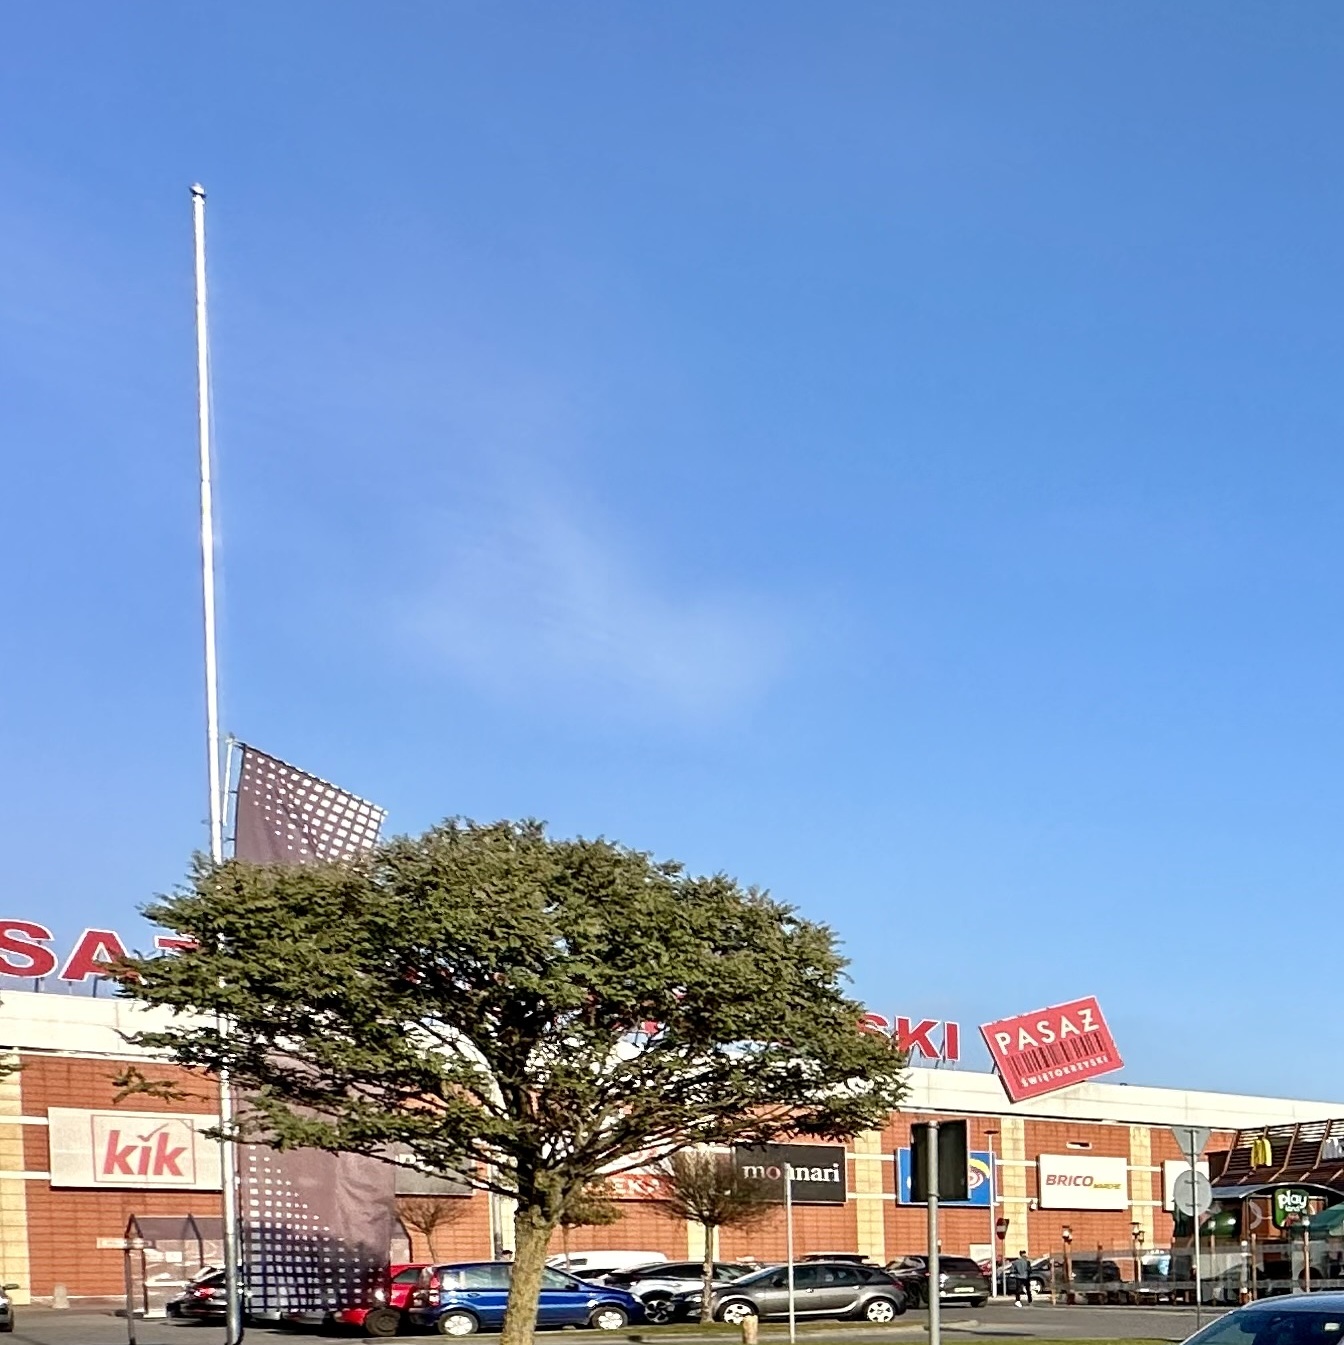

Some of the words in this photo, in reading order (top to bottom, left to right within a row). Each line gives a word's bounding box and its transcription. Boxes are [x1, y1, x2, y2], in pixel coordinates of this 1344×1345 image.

[103, 1123, 188, 1177] kik
[1045, 1174, 1094, 1187] BRICO
[1278, 1190, 1307, 1209] play
